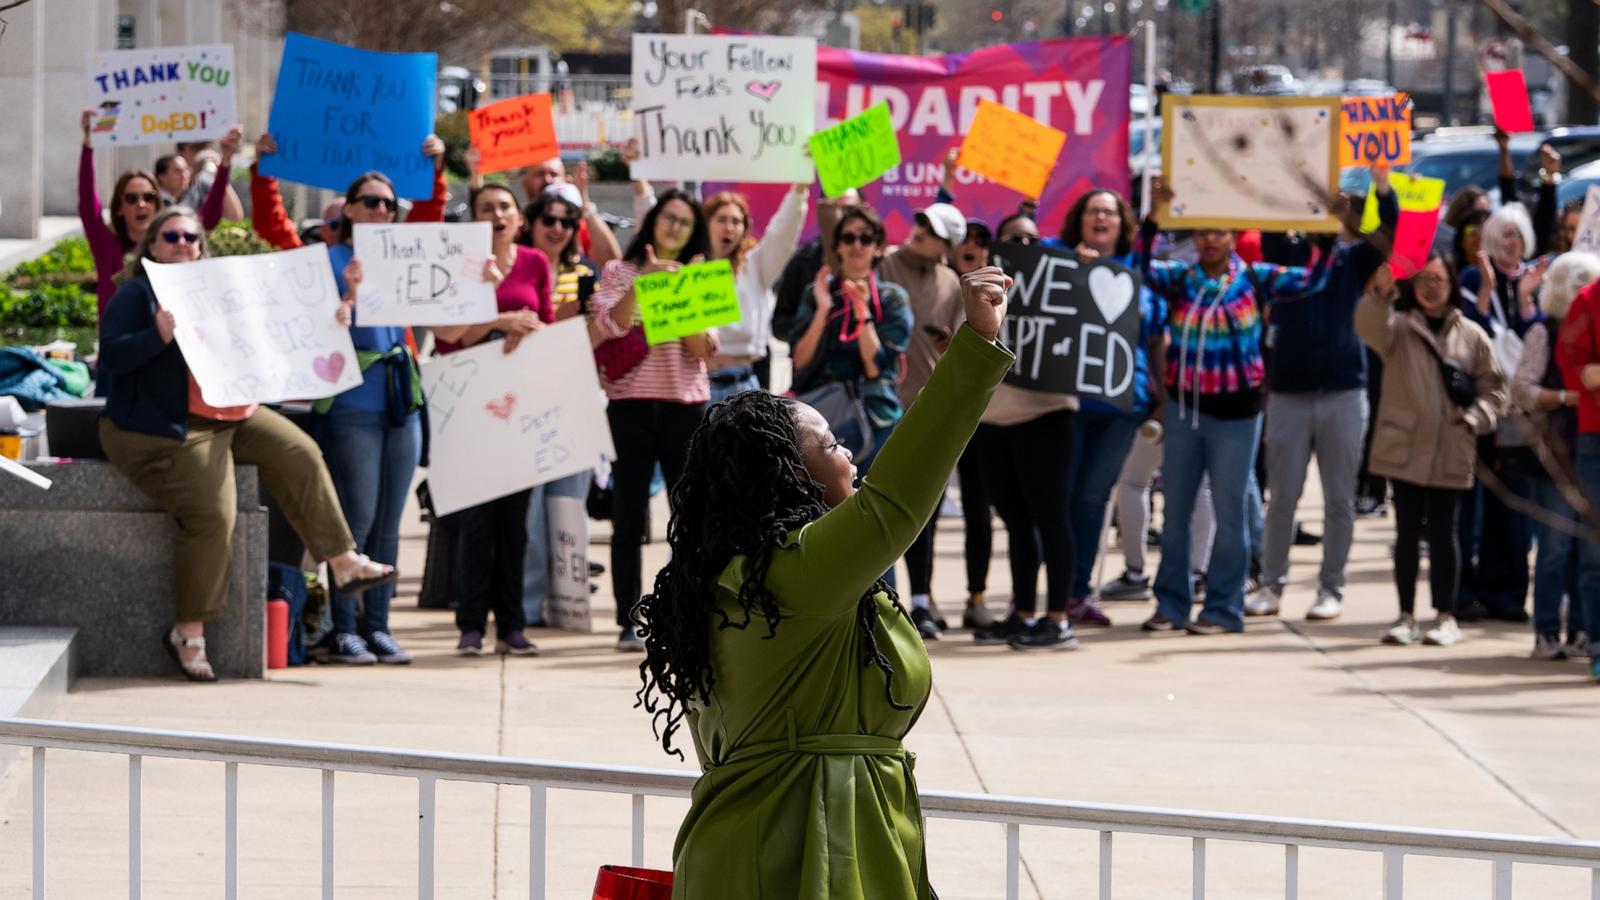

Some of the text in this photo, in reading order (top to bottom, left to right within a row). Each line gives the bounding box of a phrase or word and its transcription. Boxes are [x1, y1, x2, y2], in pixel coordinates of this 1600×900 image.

[95, 62, 230, 93] THANK YOU
[296, 56, 407, 105] THANK YOU
[644, 41, 793, 87] Your Fellow
[675, 74, 733, 99] Feds
[321, 104, 378, 140] FOR
[475, 103, 536, 129] Thank
[815, 79, 1106, 136] LIDARITY
[633, 104, 796, 160] Thank You
[1345, 130, 1401, 161] YOU
[822, 142, 876, 191] YOU
[904, 162, 996, 184] UNO
[373, 227, 426, 260] Thank
[992, 254, 1079, 316] WE
[1000, 314, 1057, 380] EPT
[1076, 322, 1135, 398] ED
[535, 446, 571, 477] ED
